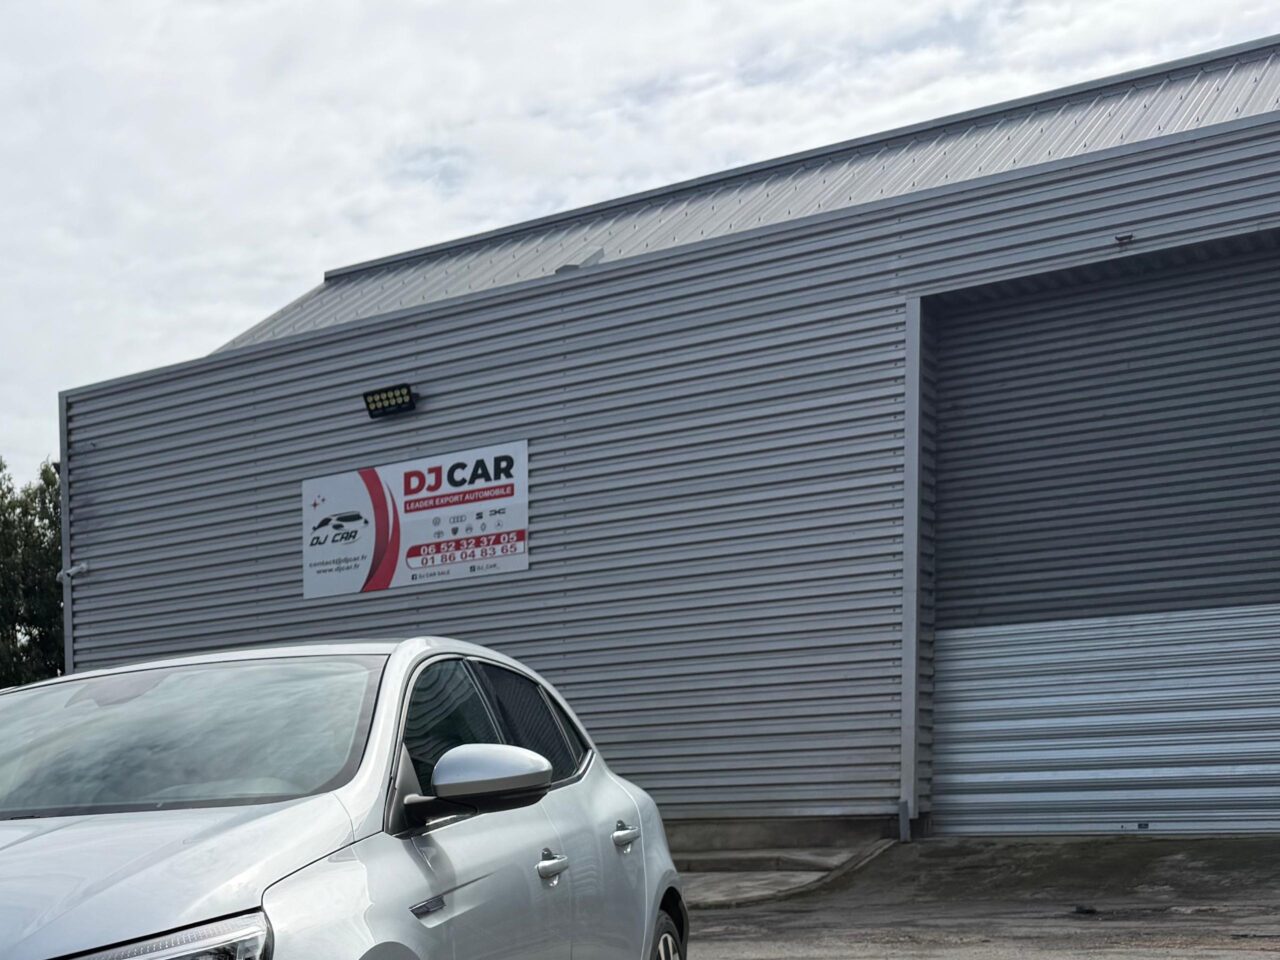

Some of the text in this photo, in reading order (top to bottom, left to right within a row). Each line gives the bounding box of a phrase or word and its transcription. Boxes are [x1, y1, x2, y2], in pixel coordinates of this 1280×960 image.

[404, 455, 514, 496] DJ CAR
[406, 486, 512, 510] LEADER EXPORT AUTOMOBILE
[310, 530, 358, 547] DJ CAR
[420, 532, 517, 556] 06 52 32 37 05
[421, 543, 517, 567] 01 86 04 83 65
